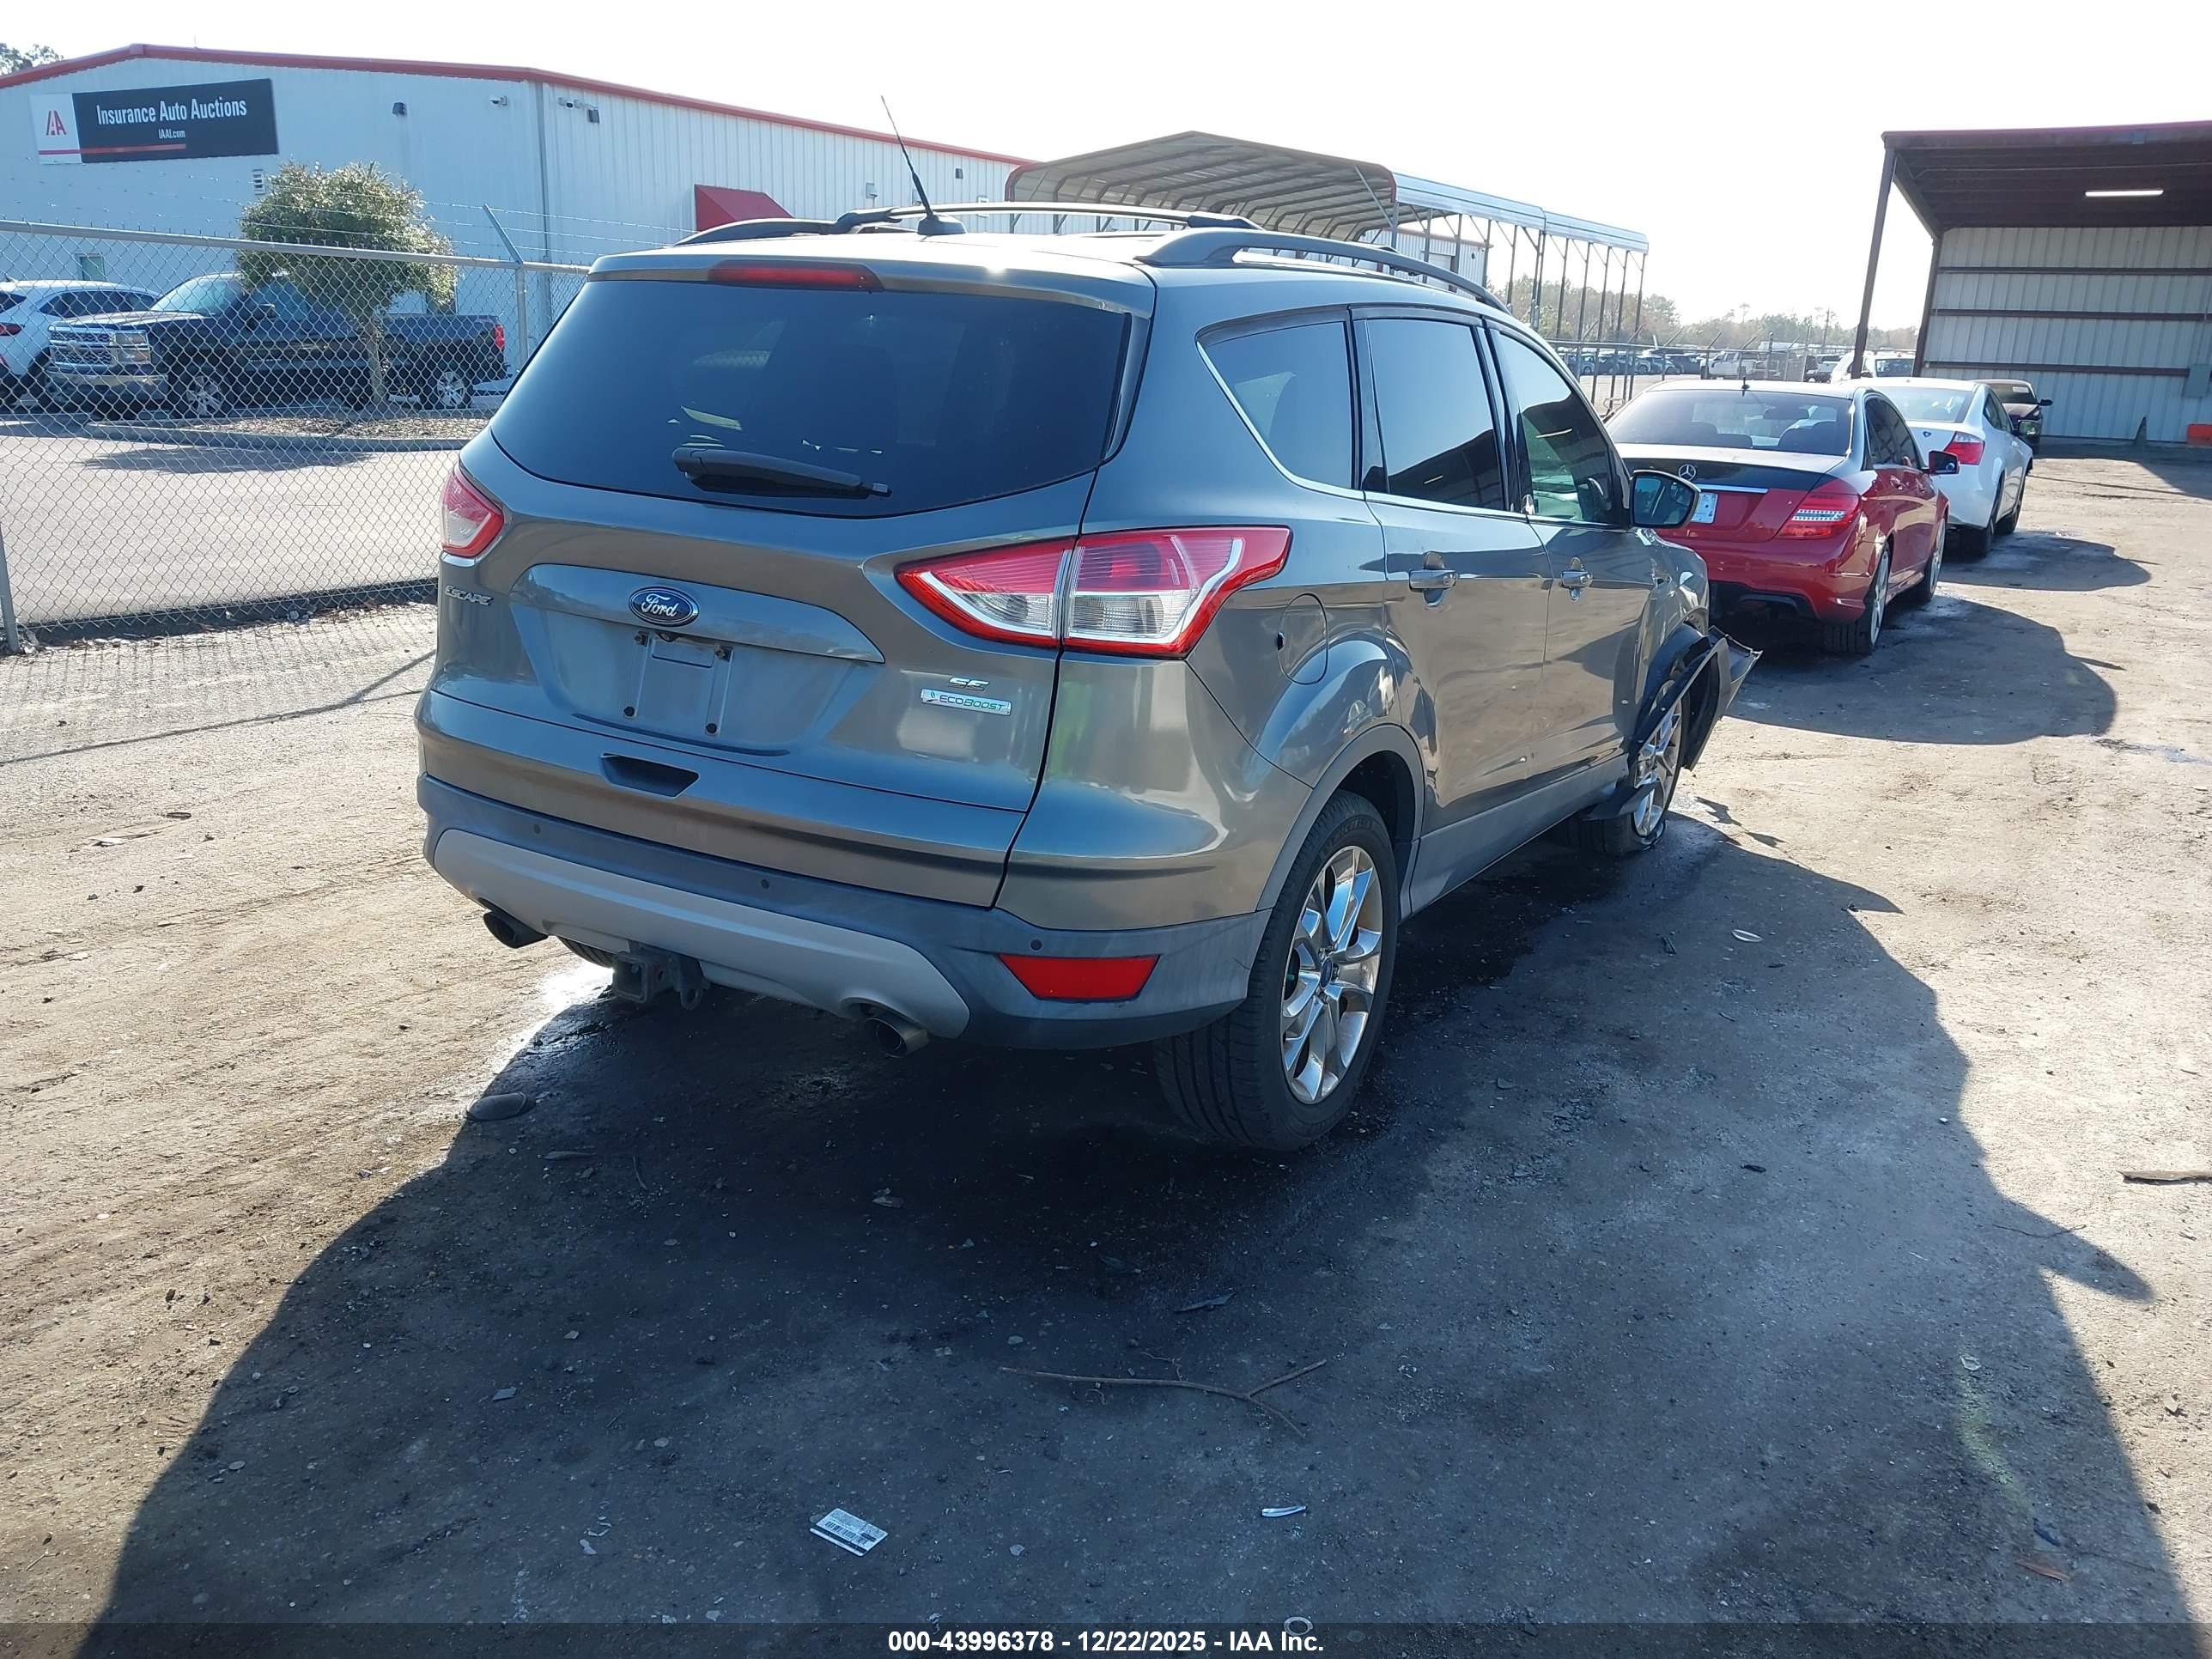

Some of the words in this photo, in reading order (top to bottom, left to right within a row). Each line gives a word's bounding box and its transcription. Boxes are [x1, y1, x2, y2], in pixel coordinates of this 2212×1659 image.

[96, 104, 156, 125] Insurance
[159, 100, 187, 121] Auto
[191, 96, 247, 119] Auctions
[640, 592, 678, 618] Ford
[948, 677, 989, 691] SE
